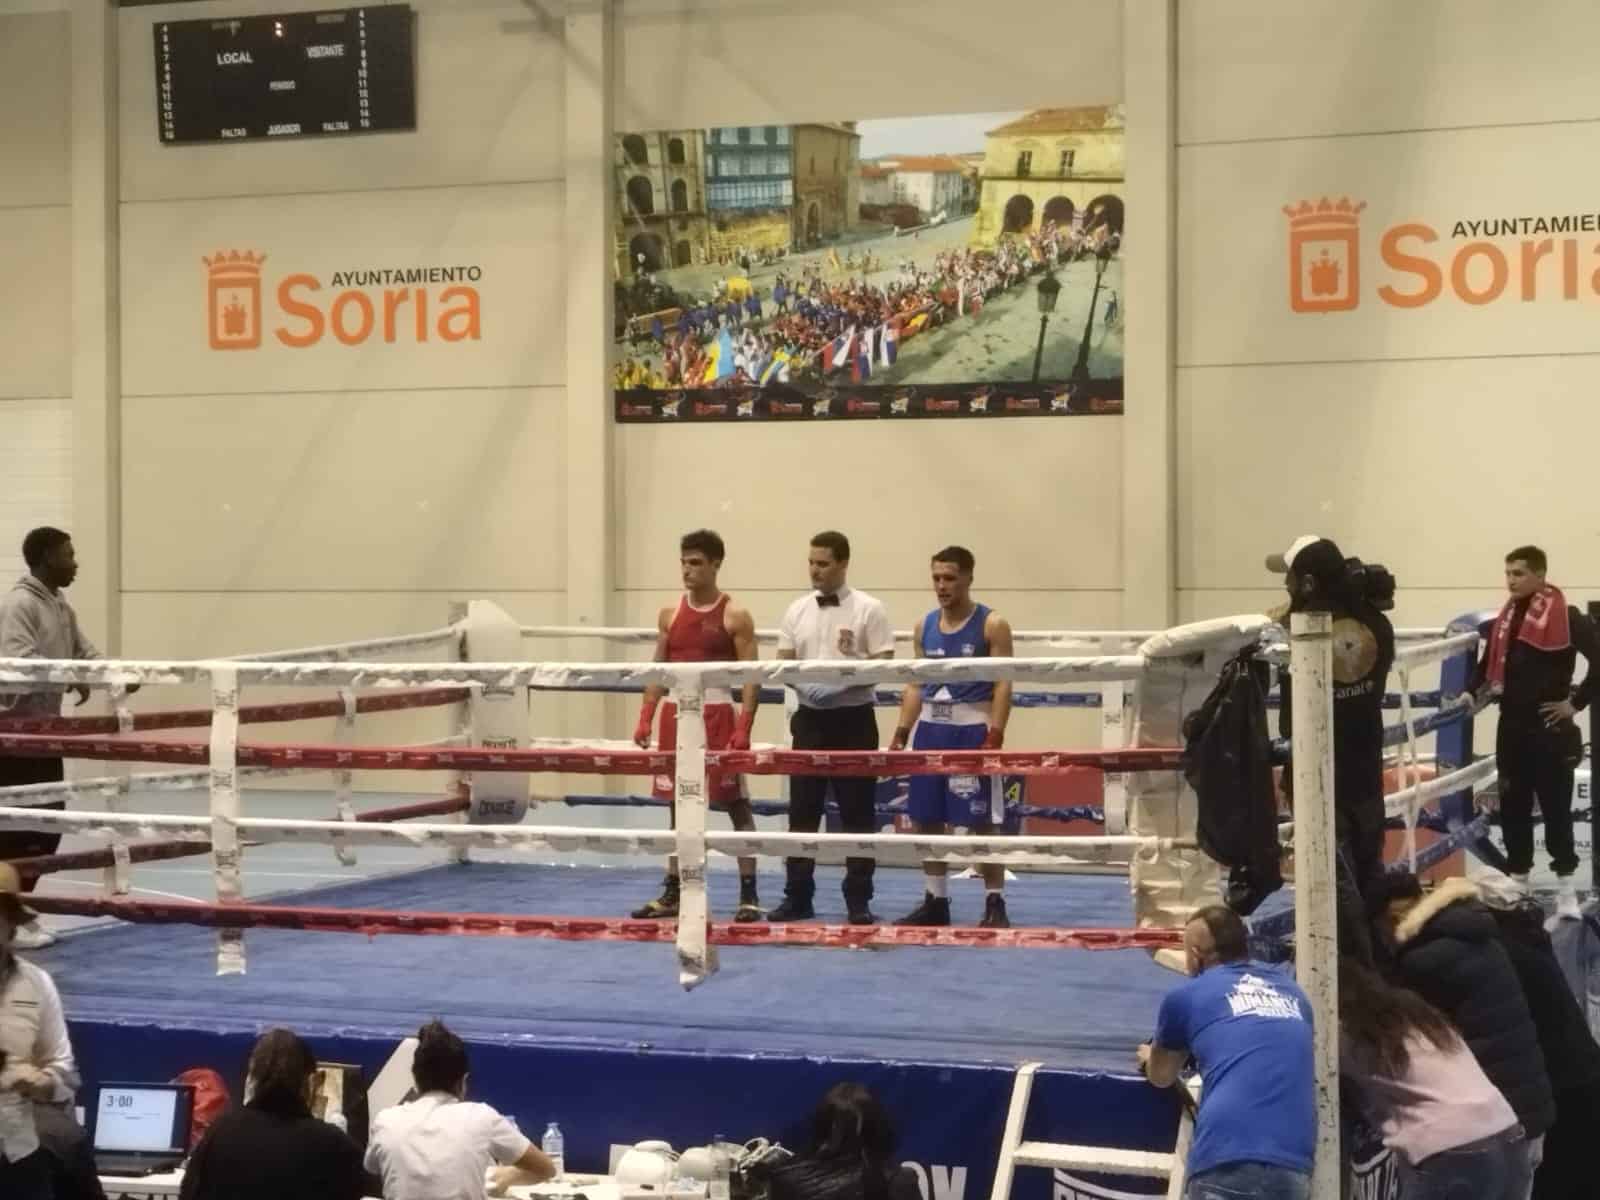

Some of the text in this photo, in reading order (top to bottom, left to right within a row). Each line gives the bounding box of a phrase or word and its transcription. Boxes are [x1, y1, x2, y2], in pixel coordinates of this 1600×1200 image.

[216, 51, 253, 65] LOCAL
[1451, 214, 1600, 239] AYUNTAMIE
[331, 265, 482, 287] AYUNTAMIENTO
[274, 272, 482, 348] Soria
